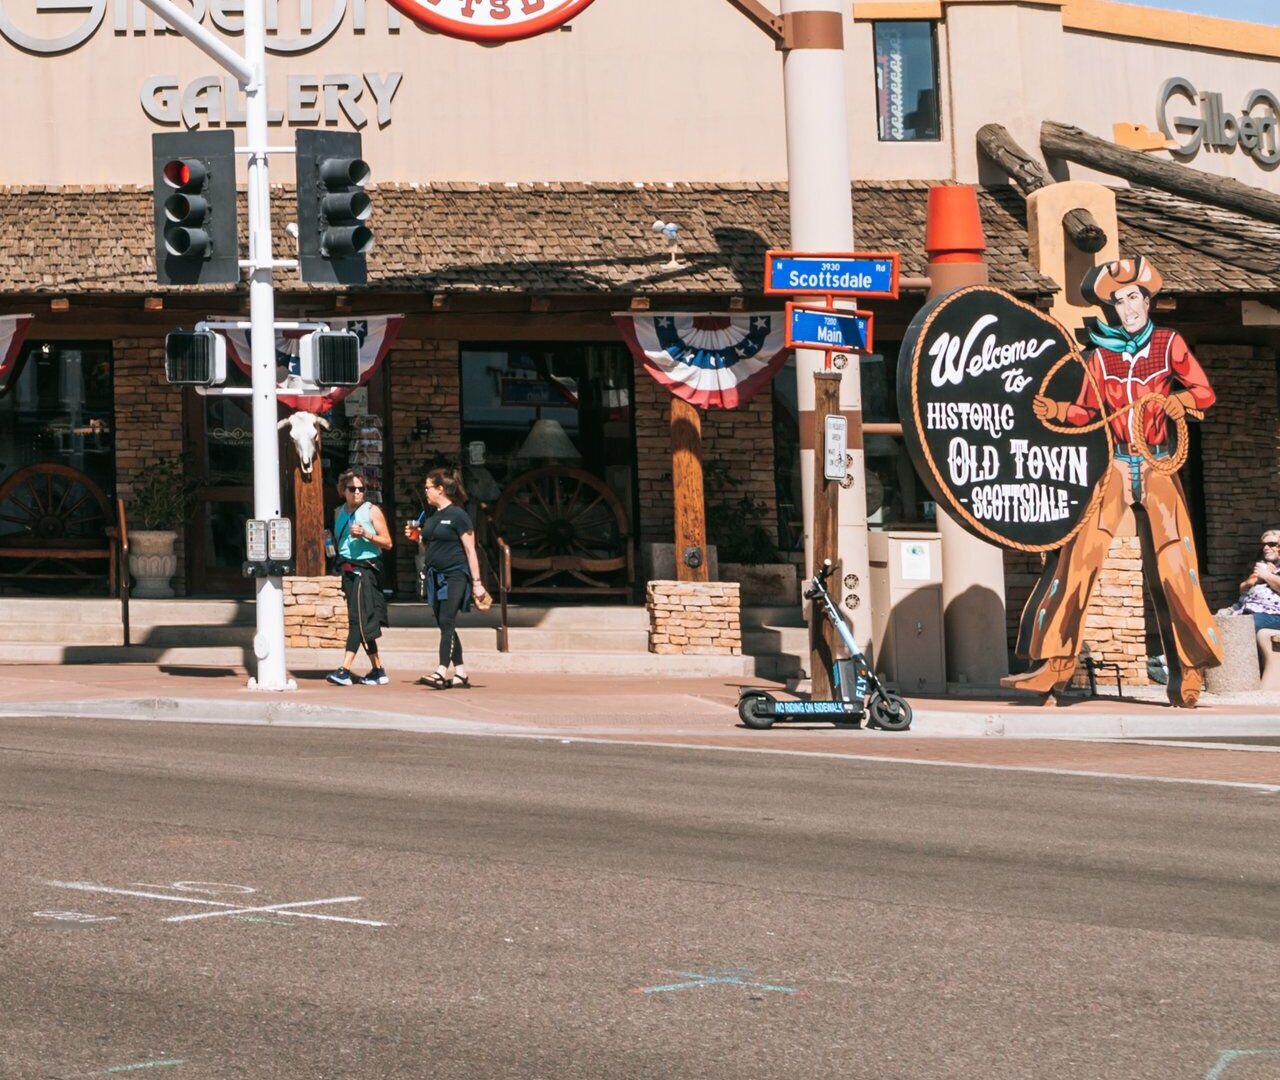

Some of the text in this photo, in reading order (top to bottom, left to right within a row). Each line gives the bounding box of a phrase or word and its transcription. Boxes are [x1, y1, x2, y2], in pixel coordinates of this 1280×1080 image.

[140, 71, 403, 131] GALERY
[776, 262, 886, 272] N 3930 Rd
[789, 270, 872, 288] Scottsdale
[794, 314, 799, 322] E
[817, 325, 843, 343] Main
[928, 314, 1056, 387] Welcome
[1001, 368, 1033, 393] to
[927, 402, 1014, 439] HISTORIC
[947, 436, 1088, 487] OLD TOWN
[971, 483, 1070, 523] SCOTTSDALE
[855, 676, 867, 699] FLY
[784, 702, 804, 712] RIDING
[804, 702, 814, 712] ON
[814, 702, 844, 713] SIDEWALK
